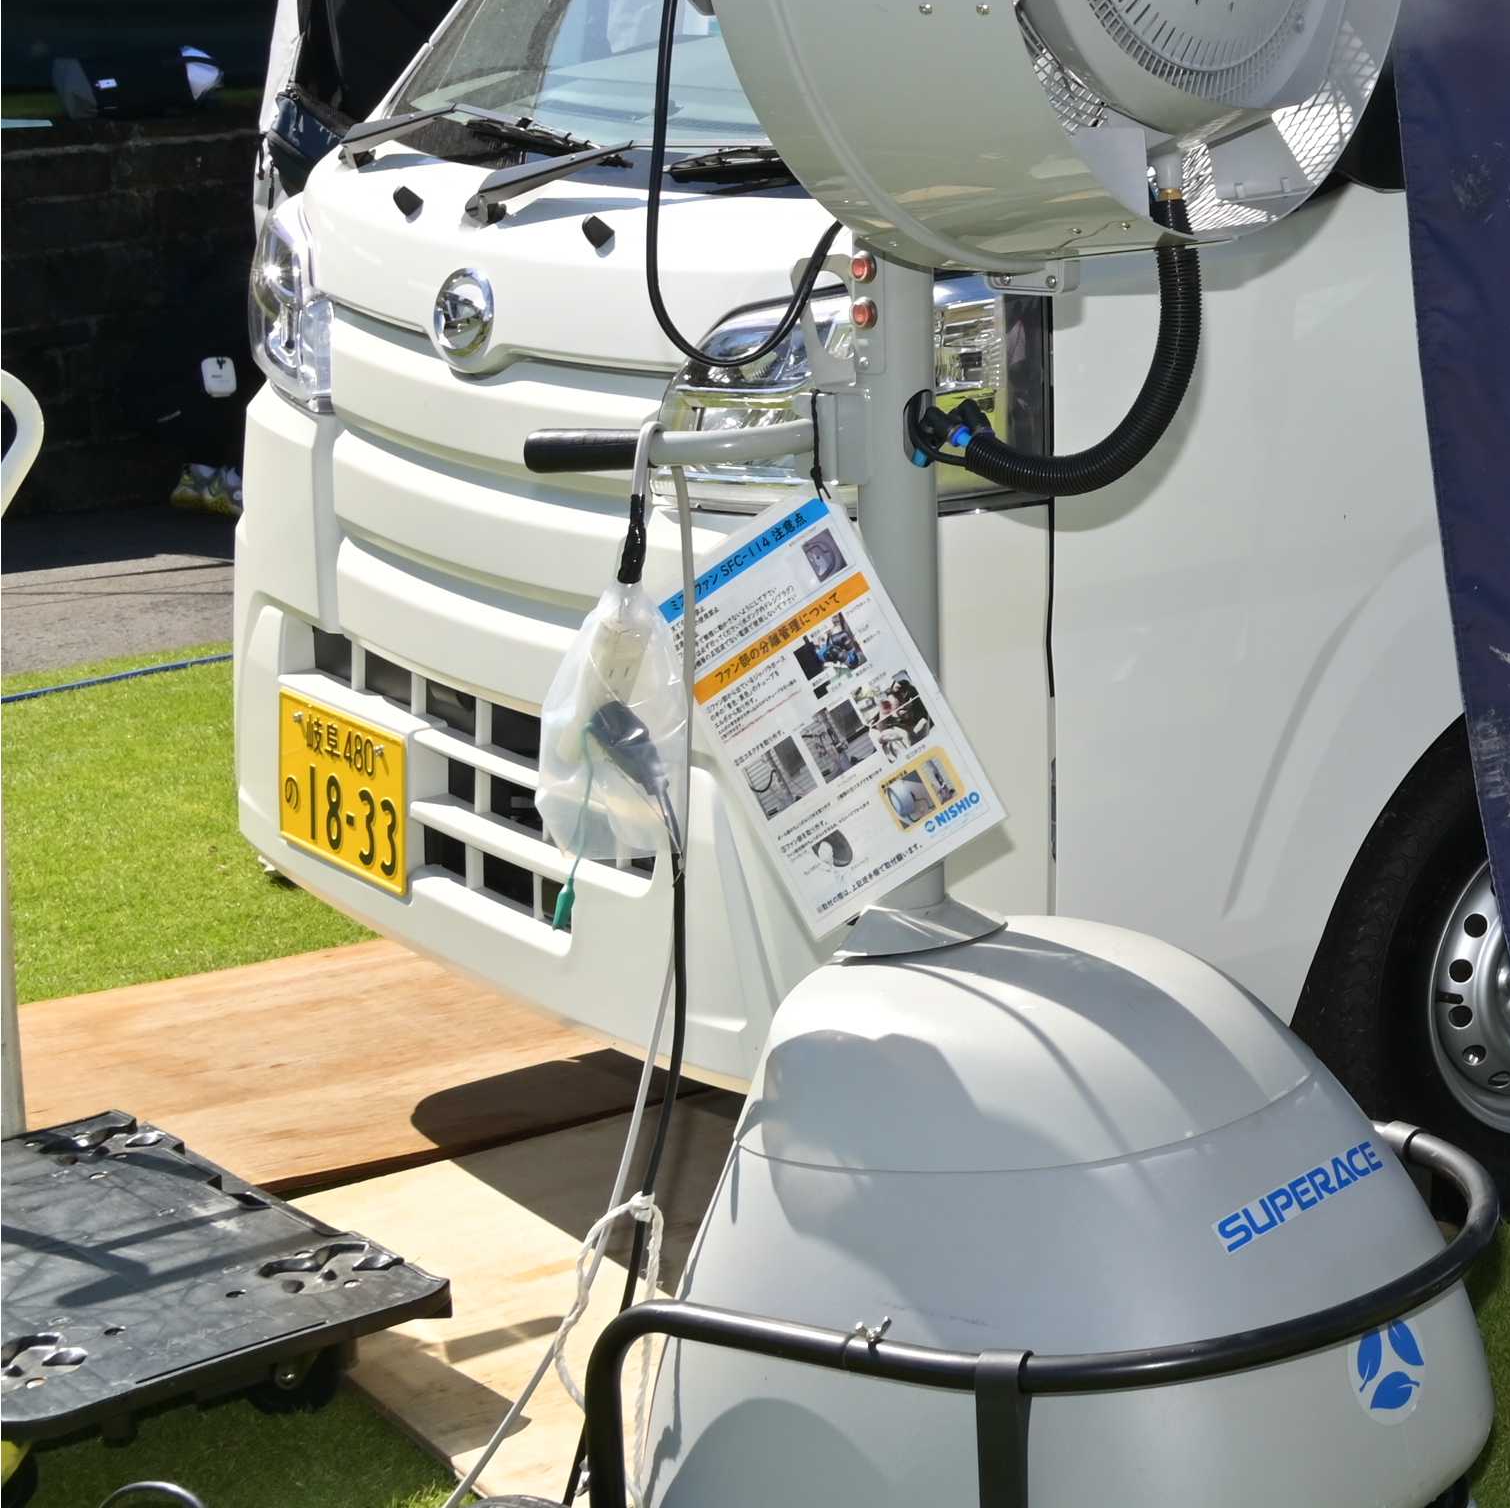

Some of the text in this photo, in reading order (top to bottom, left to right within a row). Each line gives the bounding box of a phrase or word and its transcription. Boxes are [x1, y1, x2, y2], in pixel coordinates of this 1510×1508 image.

[668, 570, 722, 612] ミファン
[305, 714, 375, 778] 岐阜 480
[284, 764, 397, 877] の 18-33
[933, 789, 981, 827] NISHIO
[1218, 1141, 1383, 1253] SUPERACE
